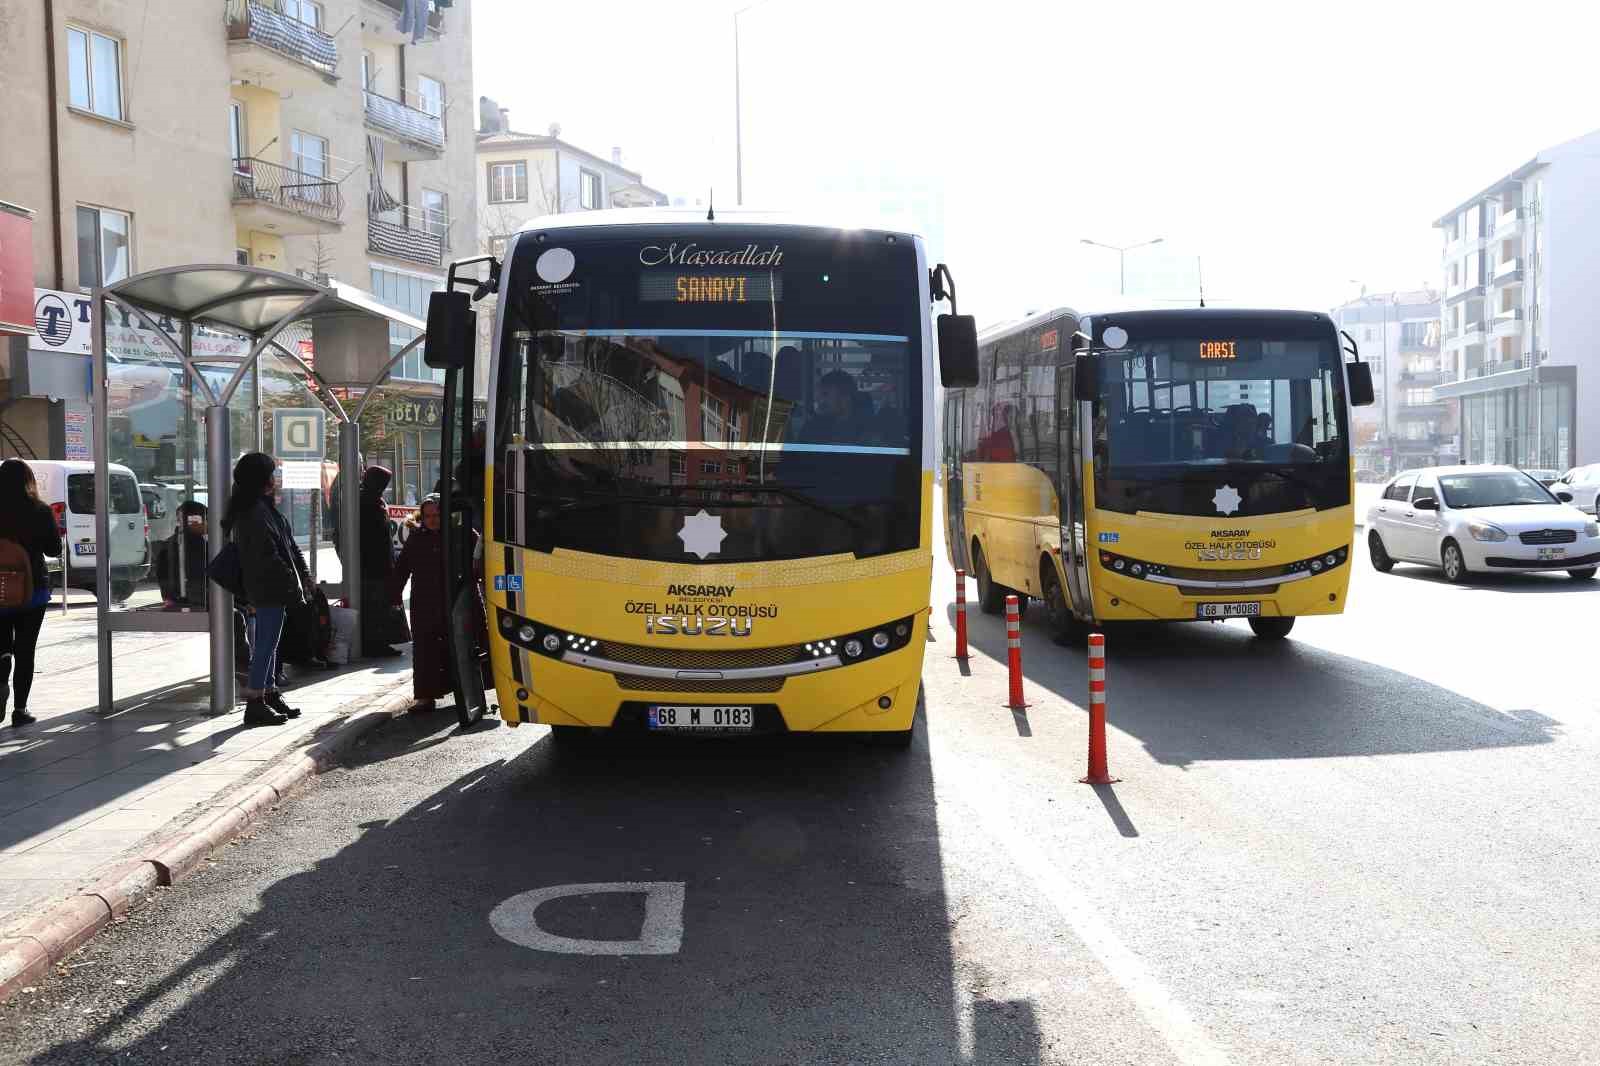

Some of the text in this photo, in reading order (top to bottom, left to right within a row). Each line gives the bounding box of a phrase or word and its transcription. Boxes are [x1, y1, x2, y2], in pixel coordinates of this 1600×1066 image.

[639, 243, 783, 267] Maşaallah
[676, 276, 747, 302] SANAYI
[1184, 541, 1207, 550] ÖZEL
[1209, 542, 1232, 550] HALK
[667, 584, 735, 598] AKSARAY
[624, 599, 778, 618] ÖZEL HALK OTOBÜSÜ
[1206, 604, 1216, 615] 68
[1224, 604, 1231, 615] M
[645, 615, 753, 636] ISUZU
[658, 708, 751, 725] 68 M 0183
